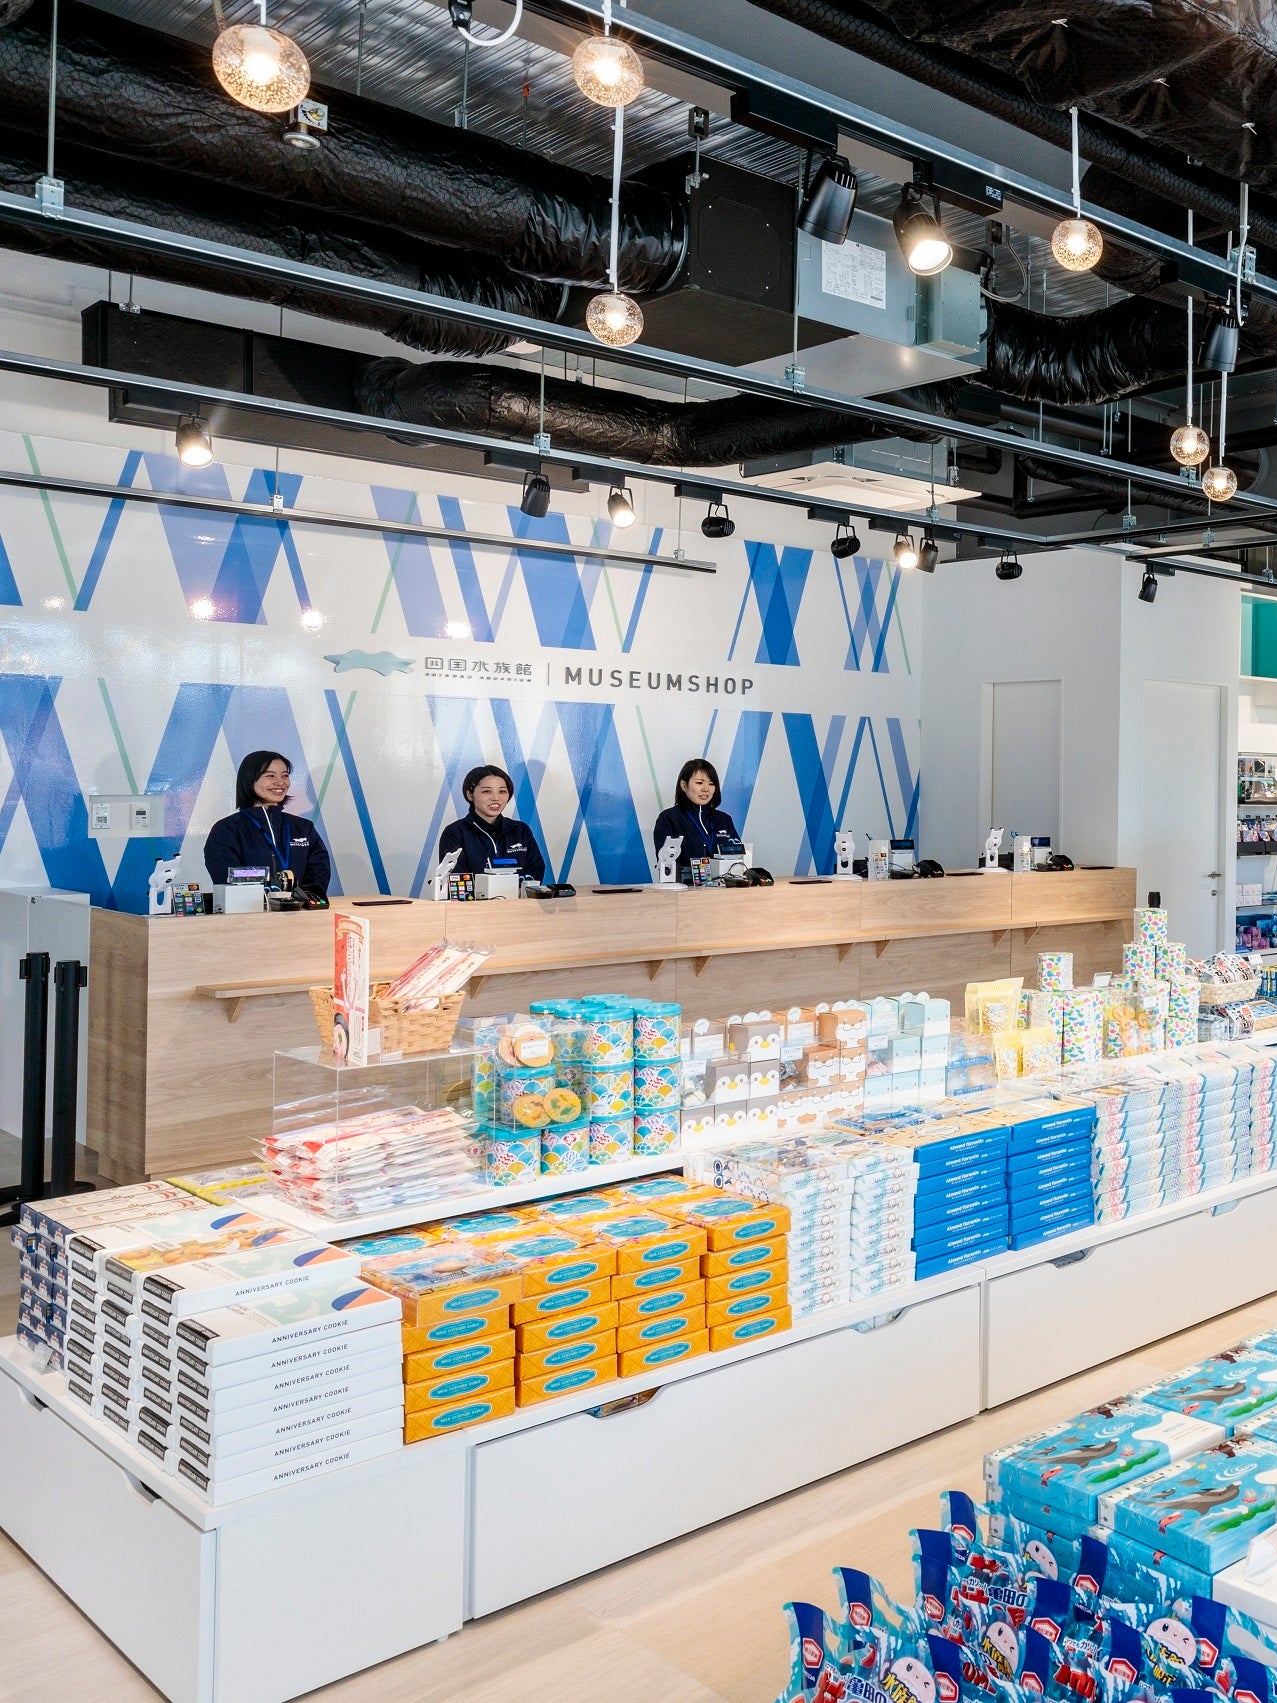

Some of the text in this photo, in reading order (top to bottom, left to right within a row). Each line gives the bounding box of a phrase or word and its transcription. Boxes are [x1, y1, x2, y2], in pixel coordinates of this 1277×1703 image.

[564, 666, 755, 696] MUSEUMSHOP
[235, 1276, 309, 1296] ANNIVERSARY COOKIE
[272, 1320, 348, 1343] ANNIVERSARY COOKIE
[271, 1344, 348, 1368] ANNIVERSARY COOKIE
[274, 1365, 350, 1390] ANNIVERSARY COOKIE
[273, 1387, 349, 1412] ANNIVERSARY COOKIE
[276, 1408, 352, 1434] ANNIVERSARY COOKIE
[274, 1430, 351, 1456] ANNIVERSARY COOKIE
[274, 1453, 350, 1480] ANNIVERSARY COOKIE
